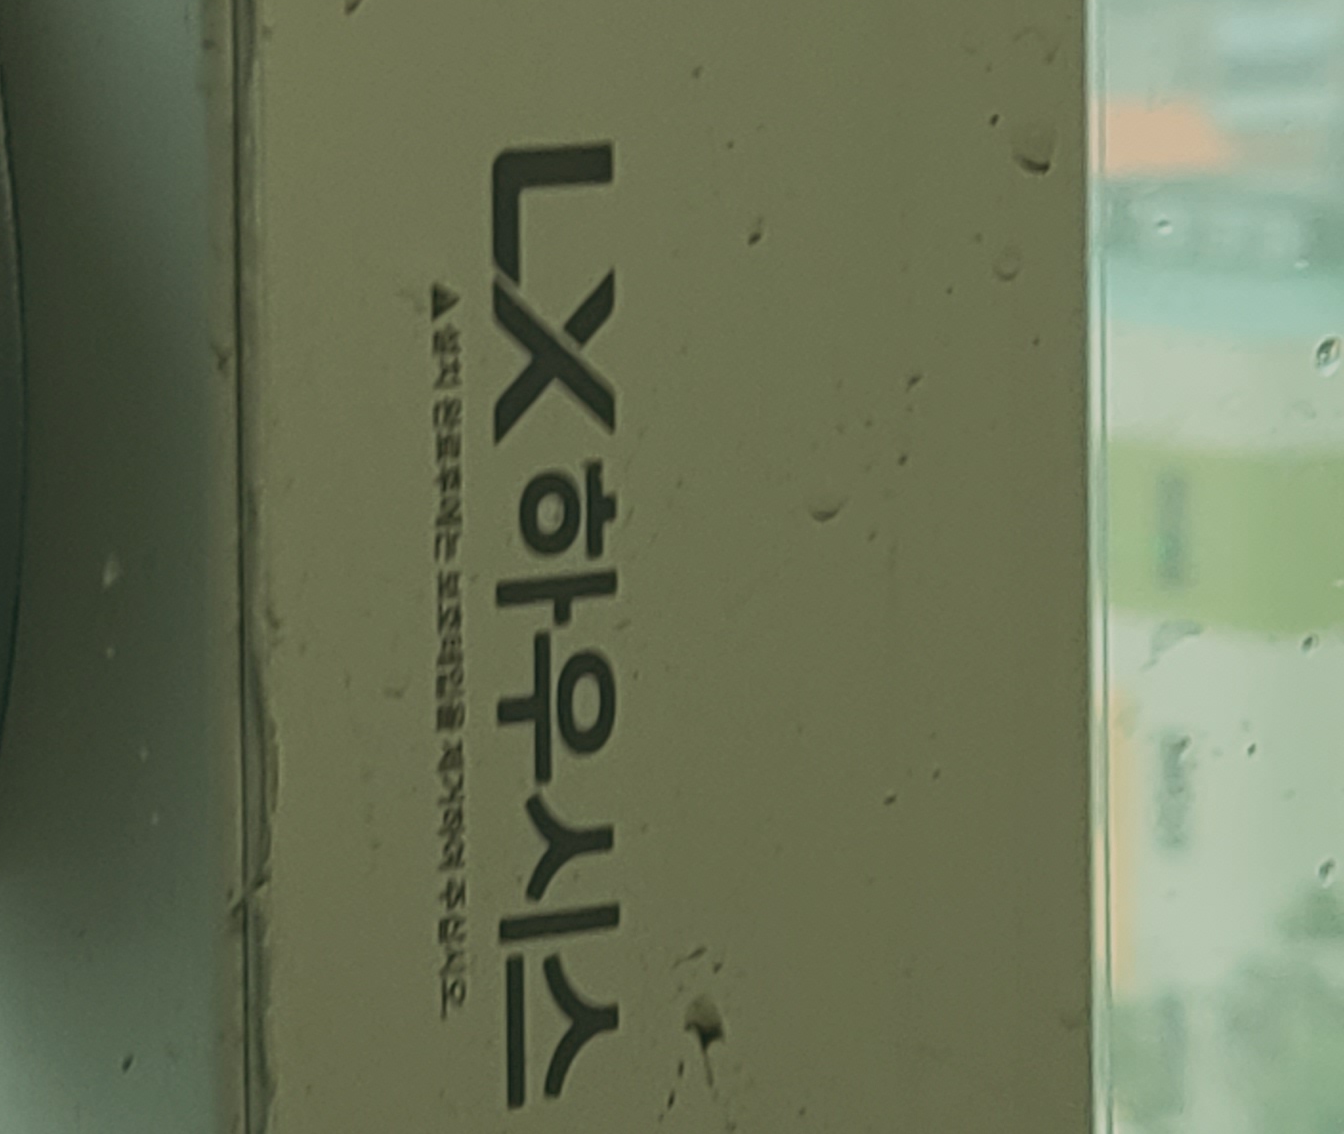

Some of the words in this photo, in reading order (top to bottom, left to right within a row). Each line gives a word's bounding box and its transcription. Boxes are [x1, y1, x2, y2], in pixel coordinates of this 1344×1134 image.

[492, 143, 615, 444] LX
[437, 739, 466, 872] 제거하여
[496, 461, 620, 1109] 하우시스
